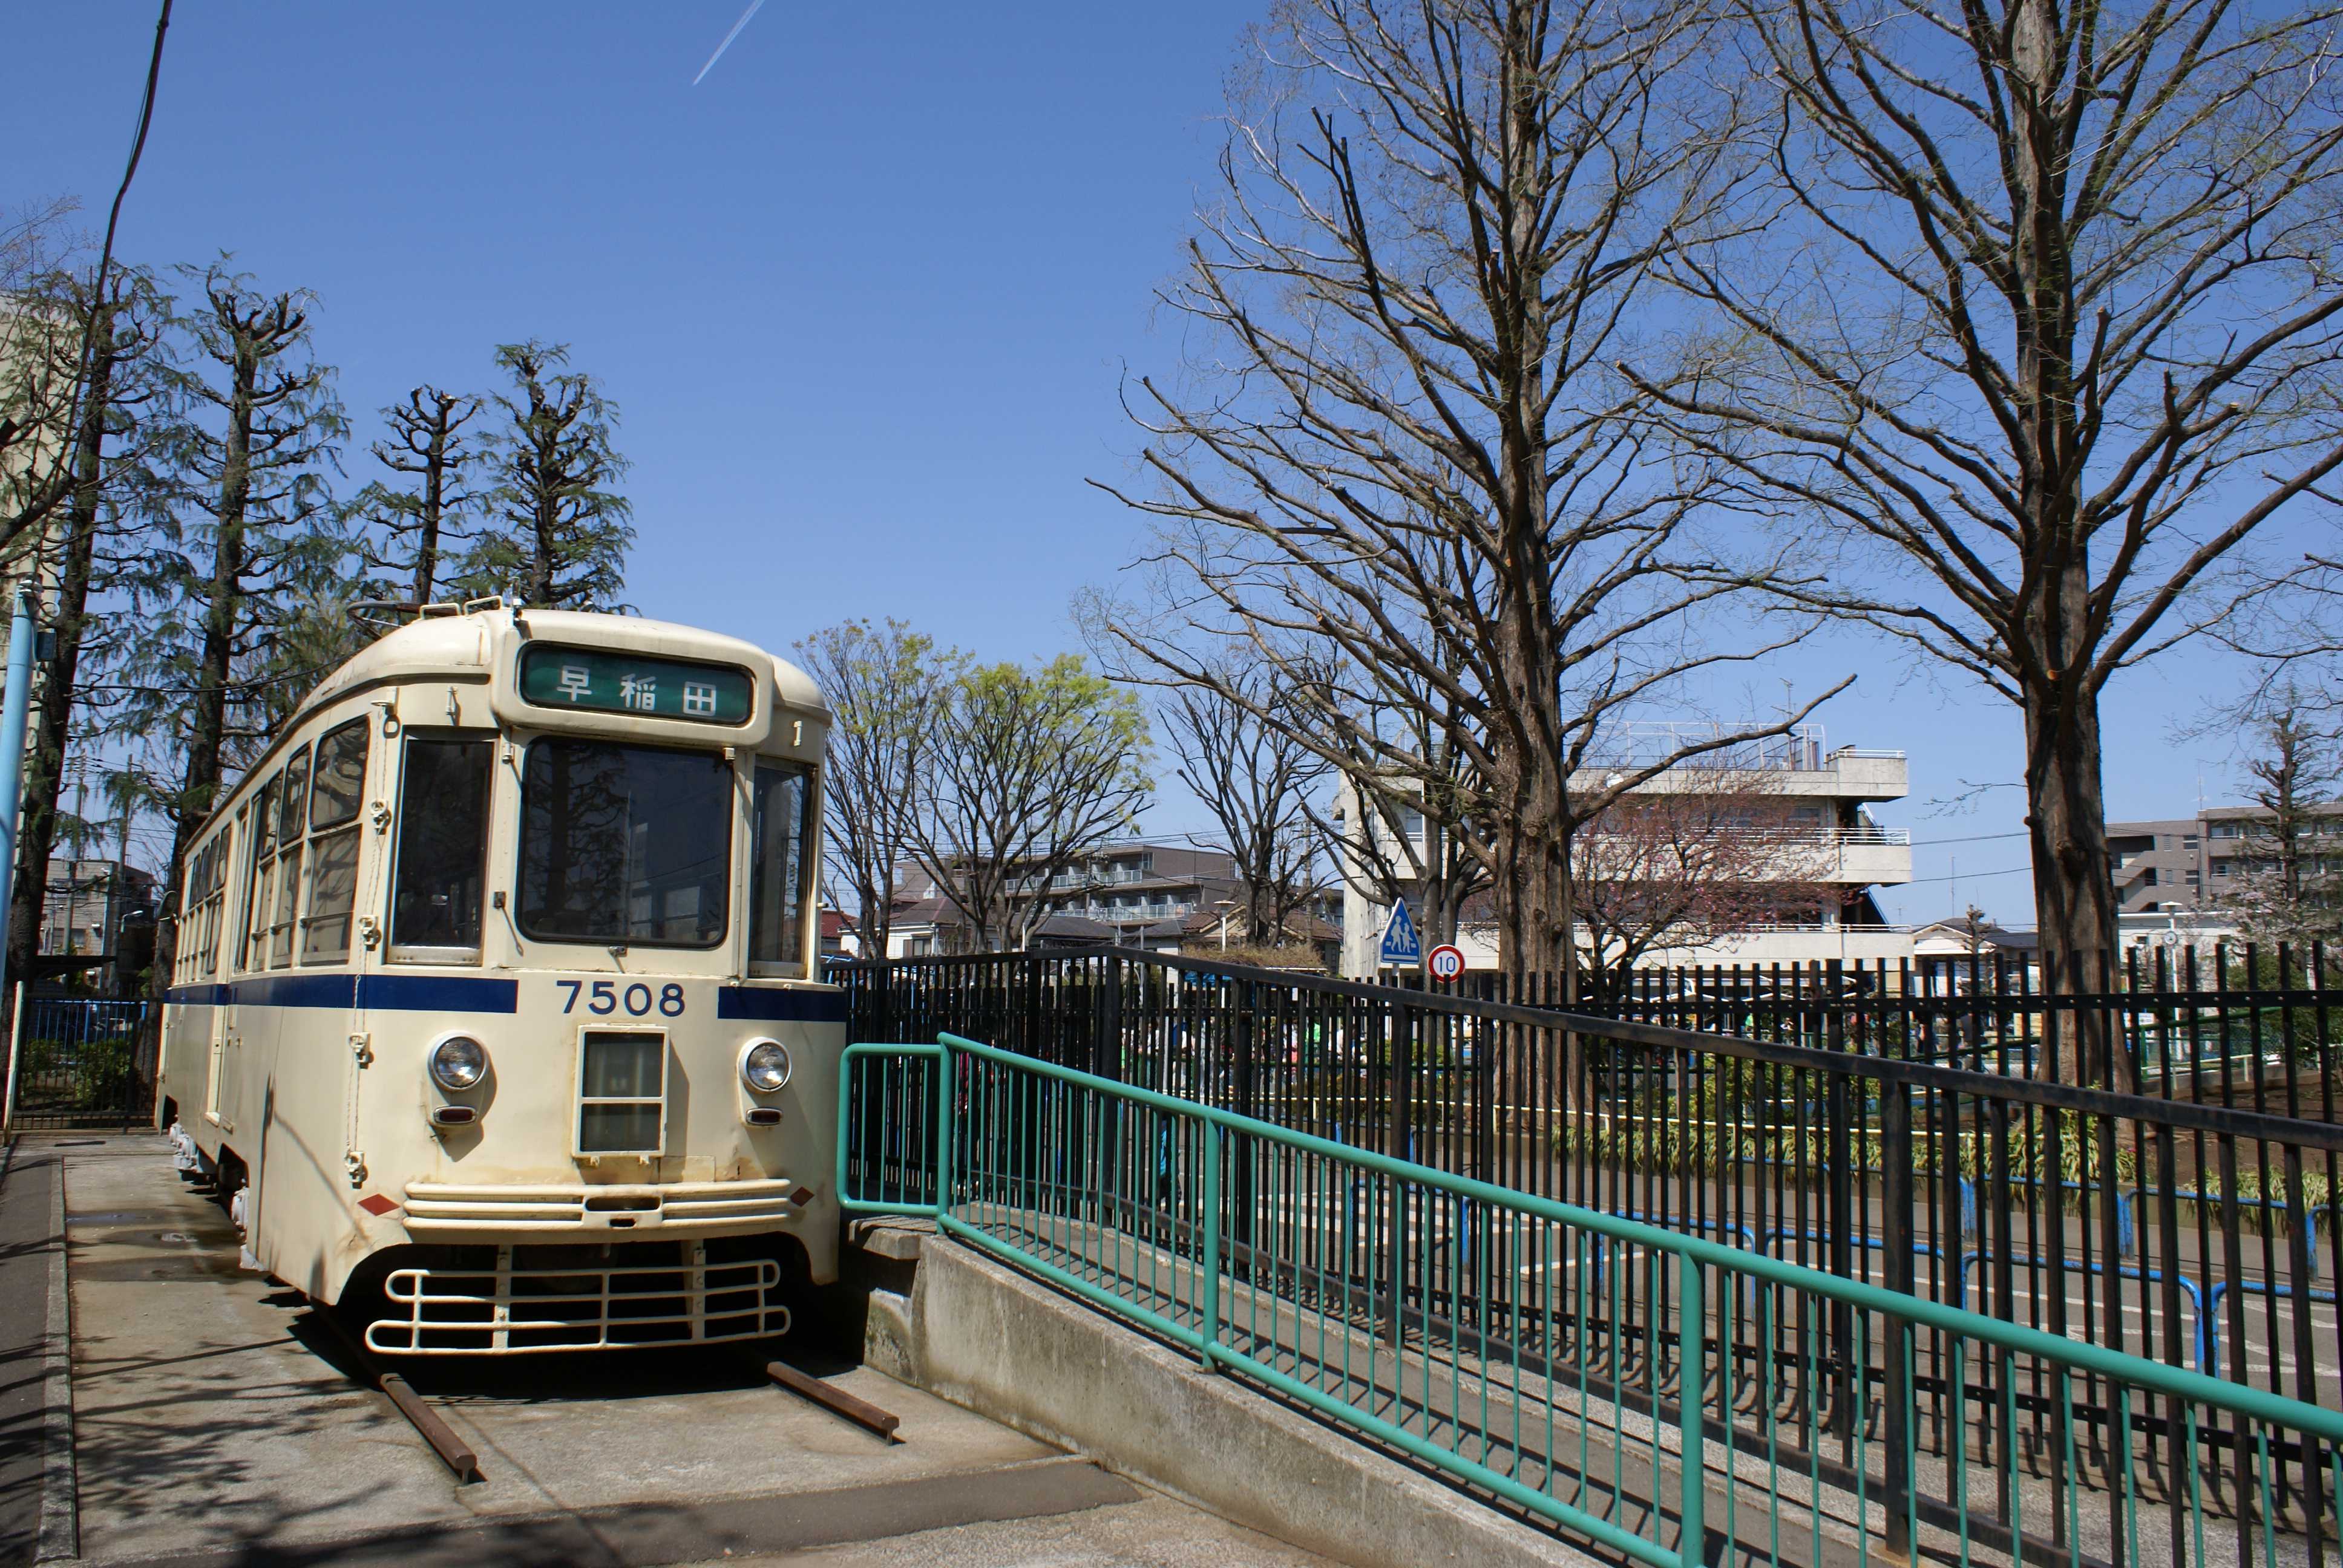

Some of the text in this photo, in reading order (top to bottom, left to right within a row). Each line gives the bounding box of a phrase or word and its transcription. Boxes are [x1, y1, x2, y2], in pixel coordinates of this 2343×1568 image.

[556, 665, 716, 716] 早稲田
[1439, 956, 1455, 972] 10
[556, 980, 685, 1017] 7508
